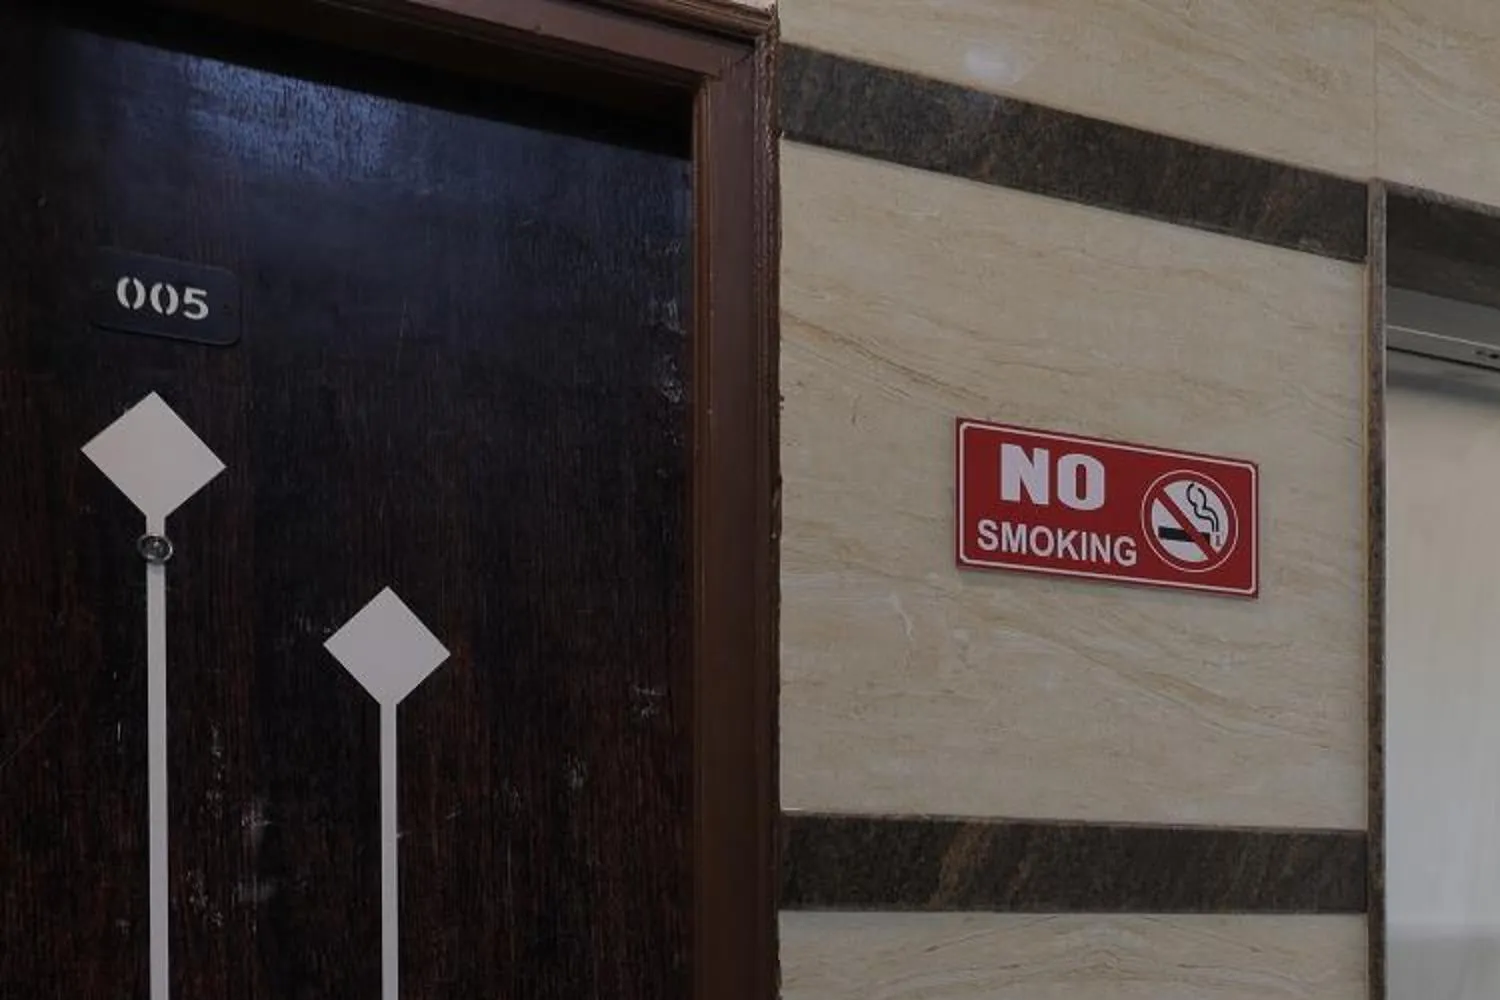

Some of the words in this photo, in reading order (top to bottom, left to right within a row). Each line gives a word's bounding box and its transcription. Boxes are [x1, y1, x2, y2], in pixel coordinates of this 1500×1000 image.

[117, 276, 208, 320] 005
[1001, 443, 1105, 511] NO
[976, 519, 1138, 567] SMOKING
